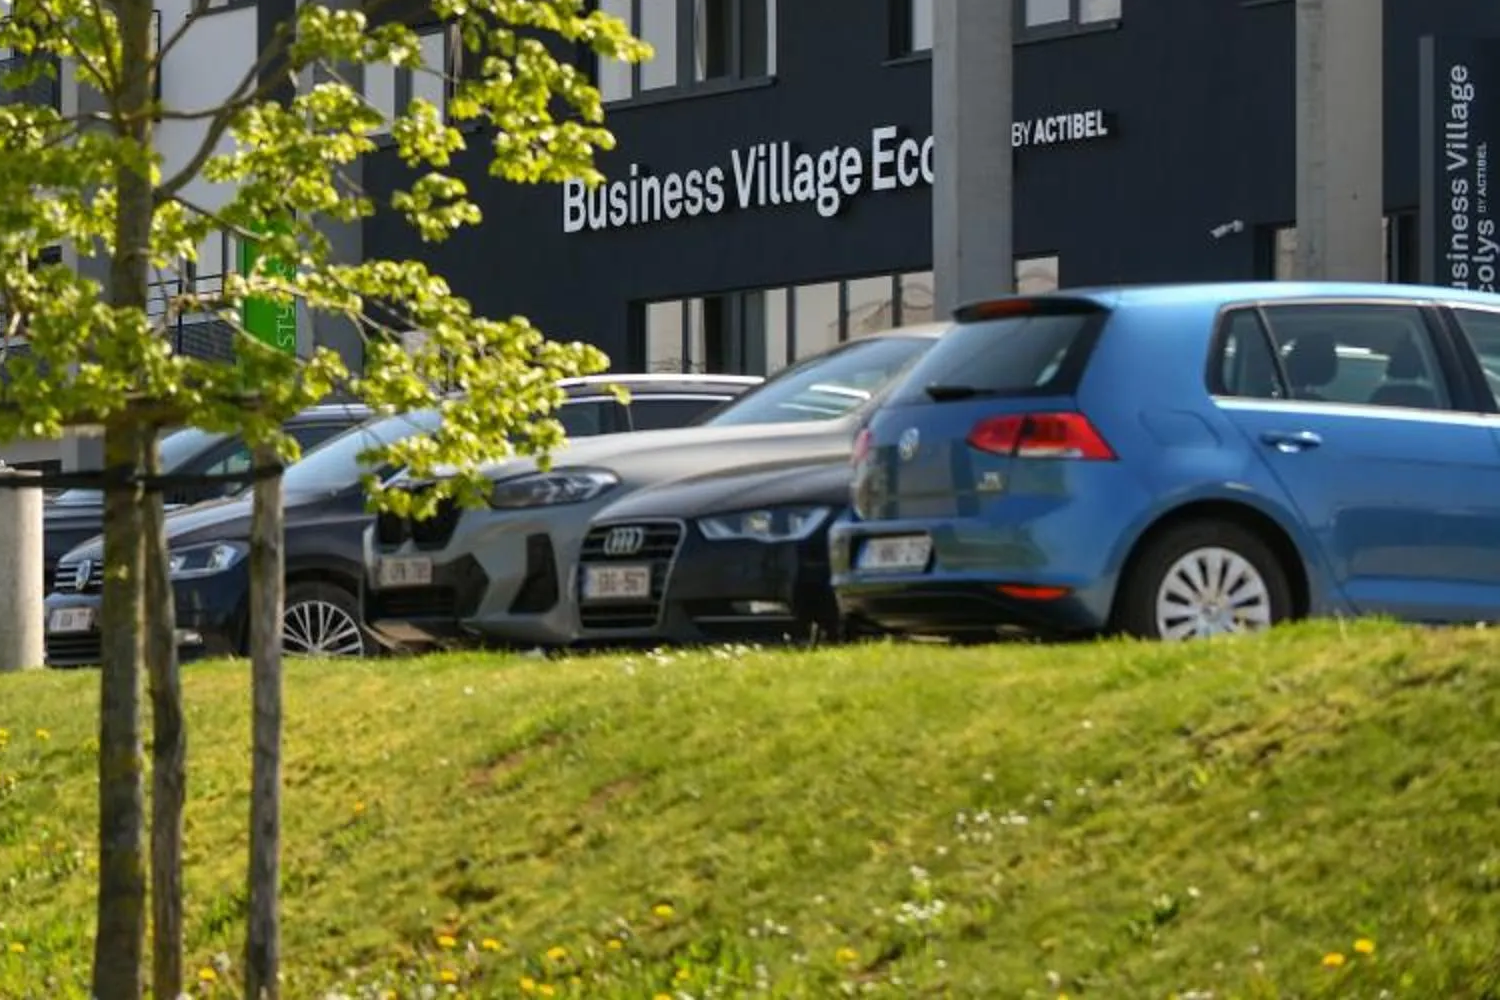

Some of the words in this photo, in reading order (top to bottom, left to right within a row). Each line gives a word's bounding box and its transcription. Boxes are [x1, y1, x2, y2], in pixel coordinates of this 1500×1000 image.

[1011, 119, 1033, 148] BY
[1033, 109, 1109, 145] ACTIBEL
[1444, 64, 1475, 172] Village
[563, 162, 725, 234] Business
[731, 140, 862, 218] Village
